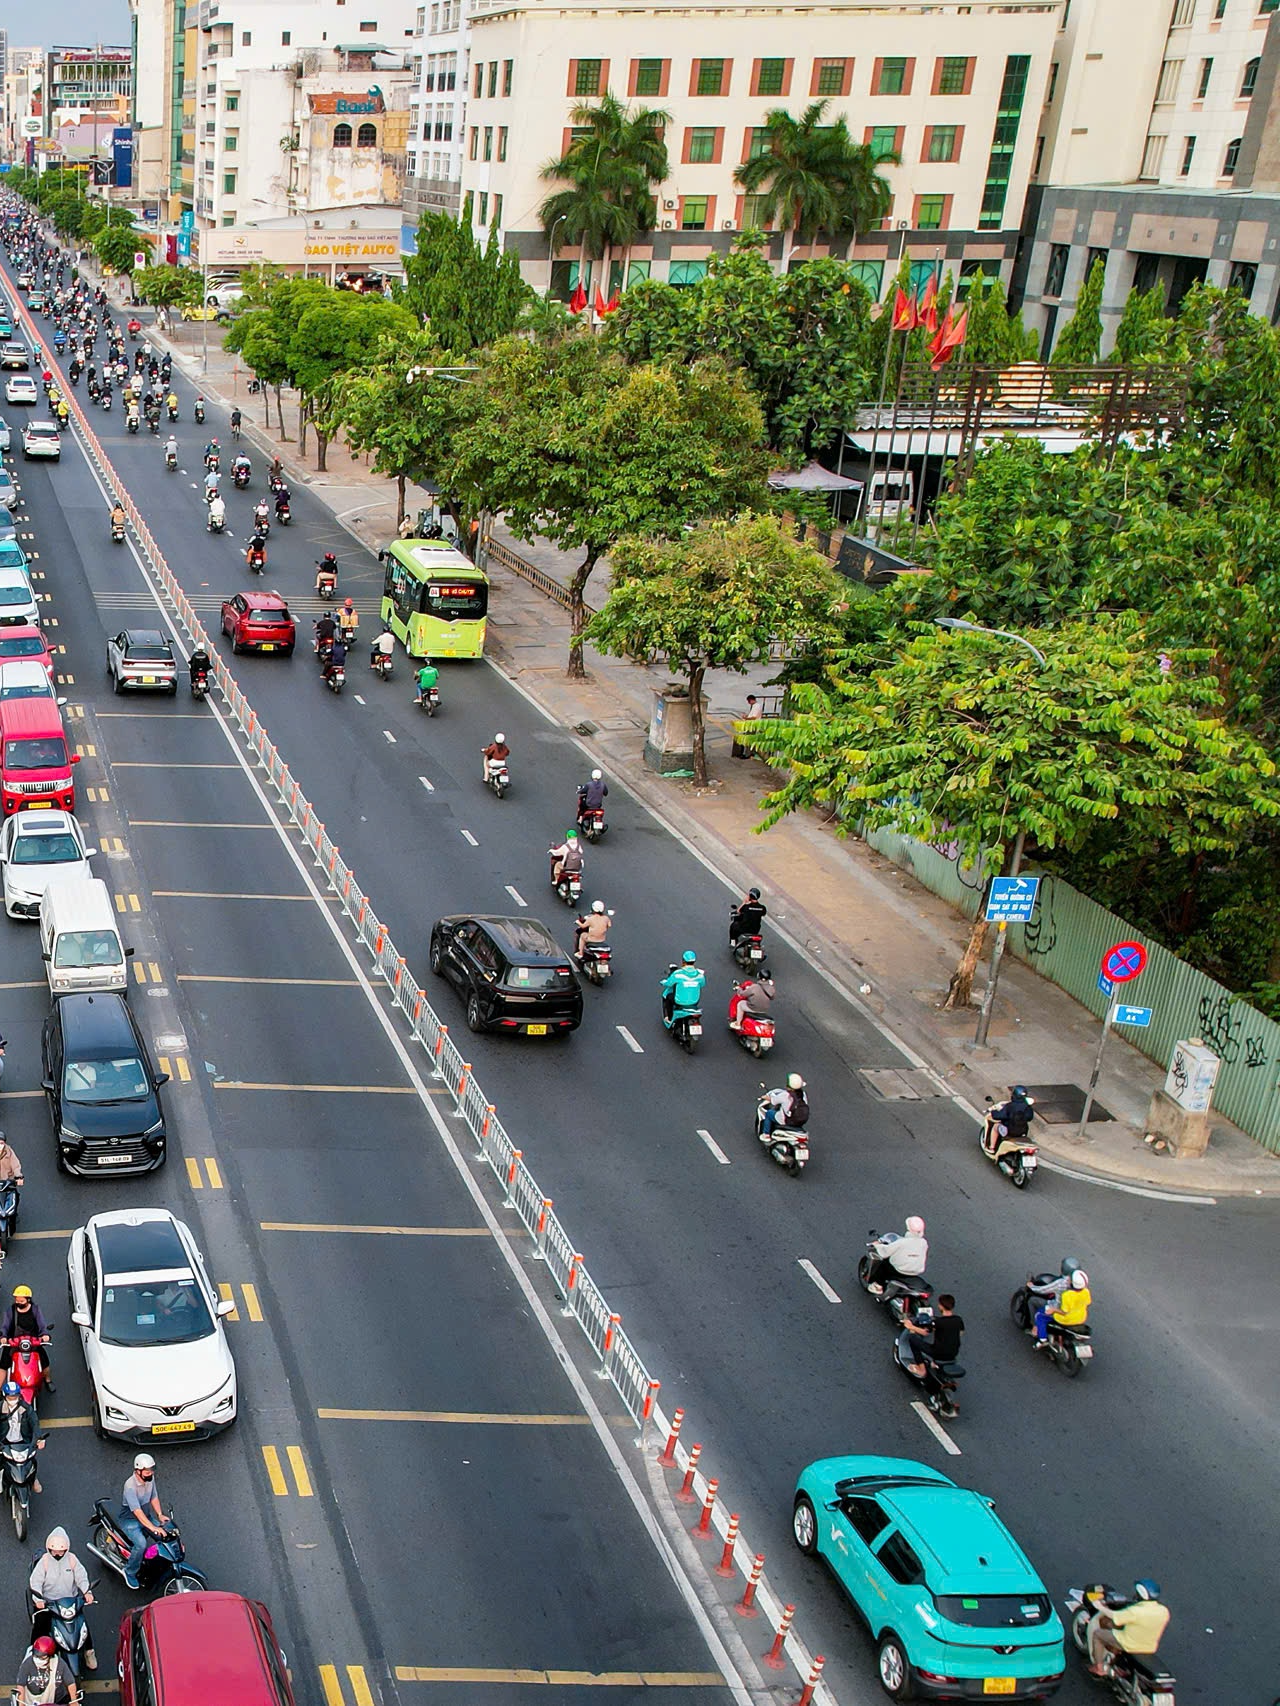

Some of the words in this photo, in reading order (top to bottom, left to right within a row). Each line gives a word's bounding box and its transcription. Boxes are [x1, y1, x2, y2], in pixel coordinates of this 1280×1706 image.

[336, 98, 375, 113] Bank
[304, 244, 329, 255] SAO
[331, 242, 359, 257] VIỆT
[362, 244, 396, 255] AUTO
